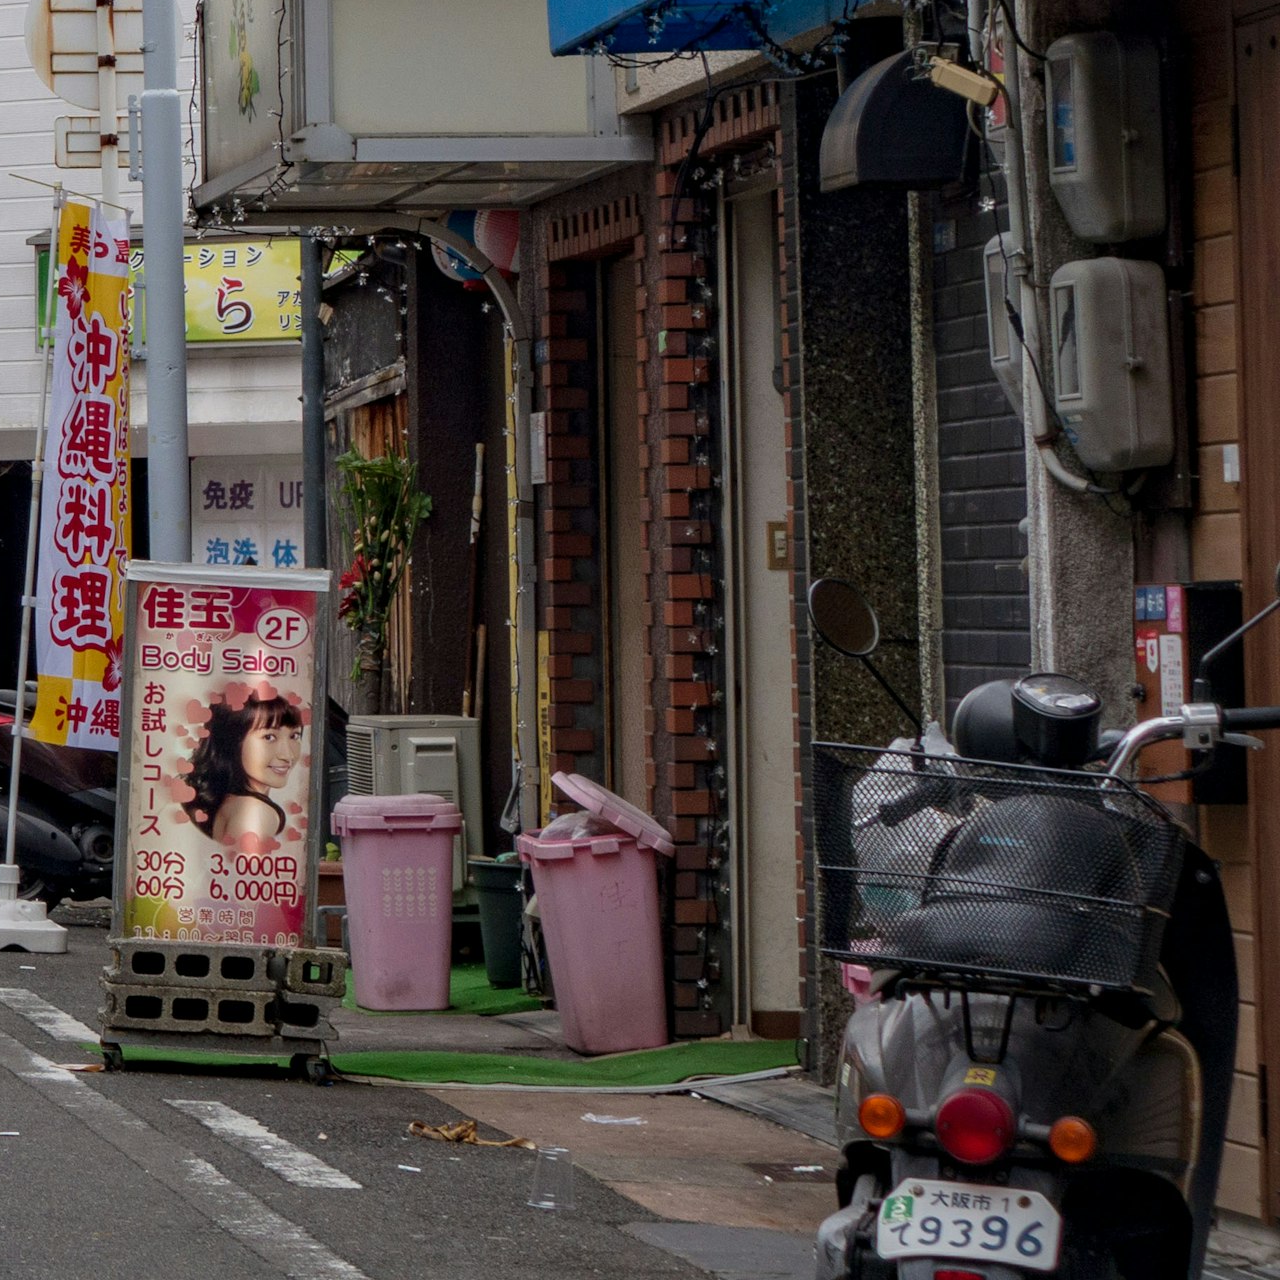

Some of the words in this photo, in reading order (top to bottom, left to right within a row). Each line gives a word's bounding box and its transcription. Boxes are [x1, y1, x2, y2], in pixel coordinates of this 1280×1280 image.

[54, 314, 115, 642] 沖縄料理
[202, 479, 254, 511] 免疫
[143, 587, 231, 630] 佳玉
[264, 615, 301, 641] 2F
[142, 644, 212, 672] Body
[222, 648, 296, 673] Salon
[140, 681, 168, 838] お試しコース
[137, 850, 186, 874] 30分
[136, 875, 185, 900] 60分
[178, 907, 255, 926] 営業時間
[930, 1190, 993, 1211] 大阪市
